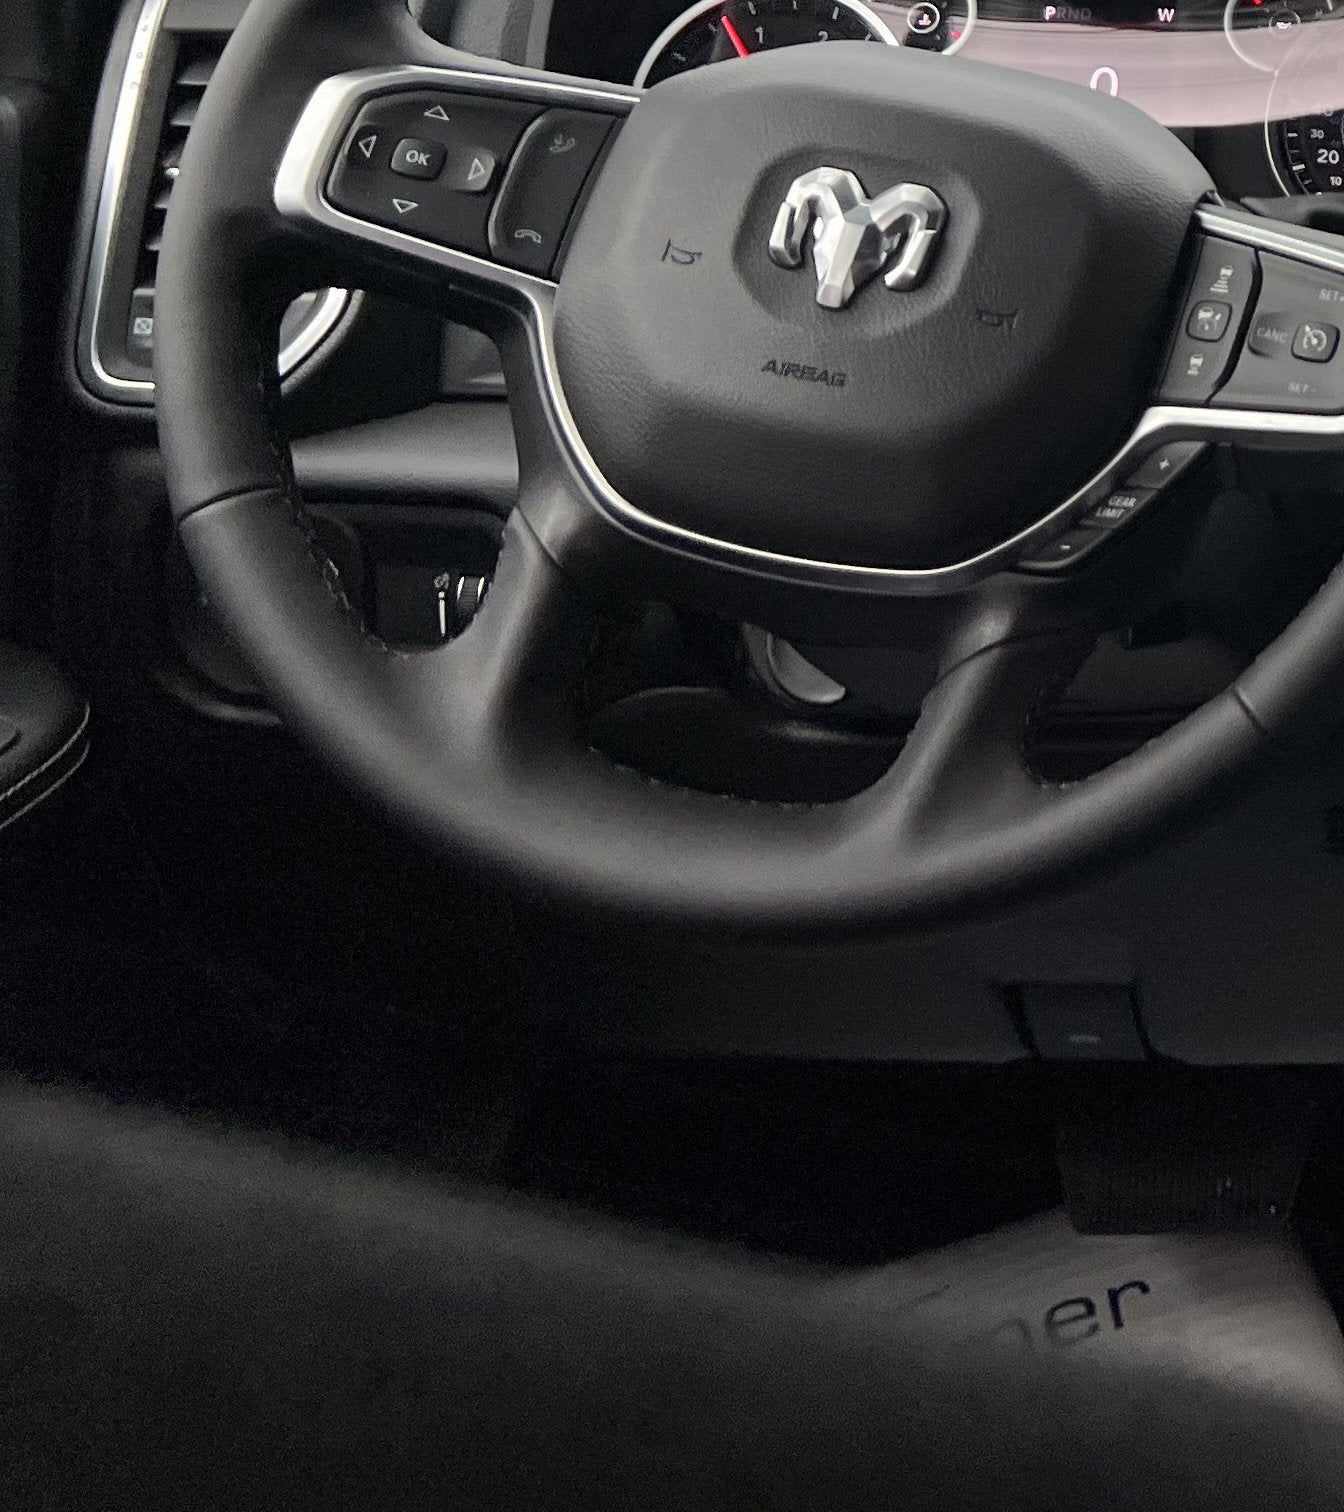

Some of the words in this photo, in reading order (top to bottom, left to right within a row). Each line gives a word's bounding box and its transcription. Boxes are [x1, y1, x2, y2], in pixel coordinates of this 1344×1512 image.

[1157, 7, 1174, 23] W
[754, 26, 764, 44] 1
[1310, 129, 1325, 139] 30
[405, 149, 431, 167] OK
[1317, 149, 1340, 164] 20
[1330, 176, 1342, 186] 10
[760, 359, 848, 388] AIRBAG
[1108, 496, 1137, 508] GEAR
[1096, 507, 1125, 519] LIMIT
